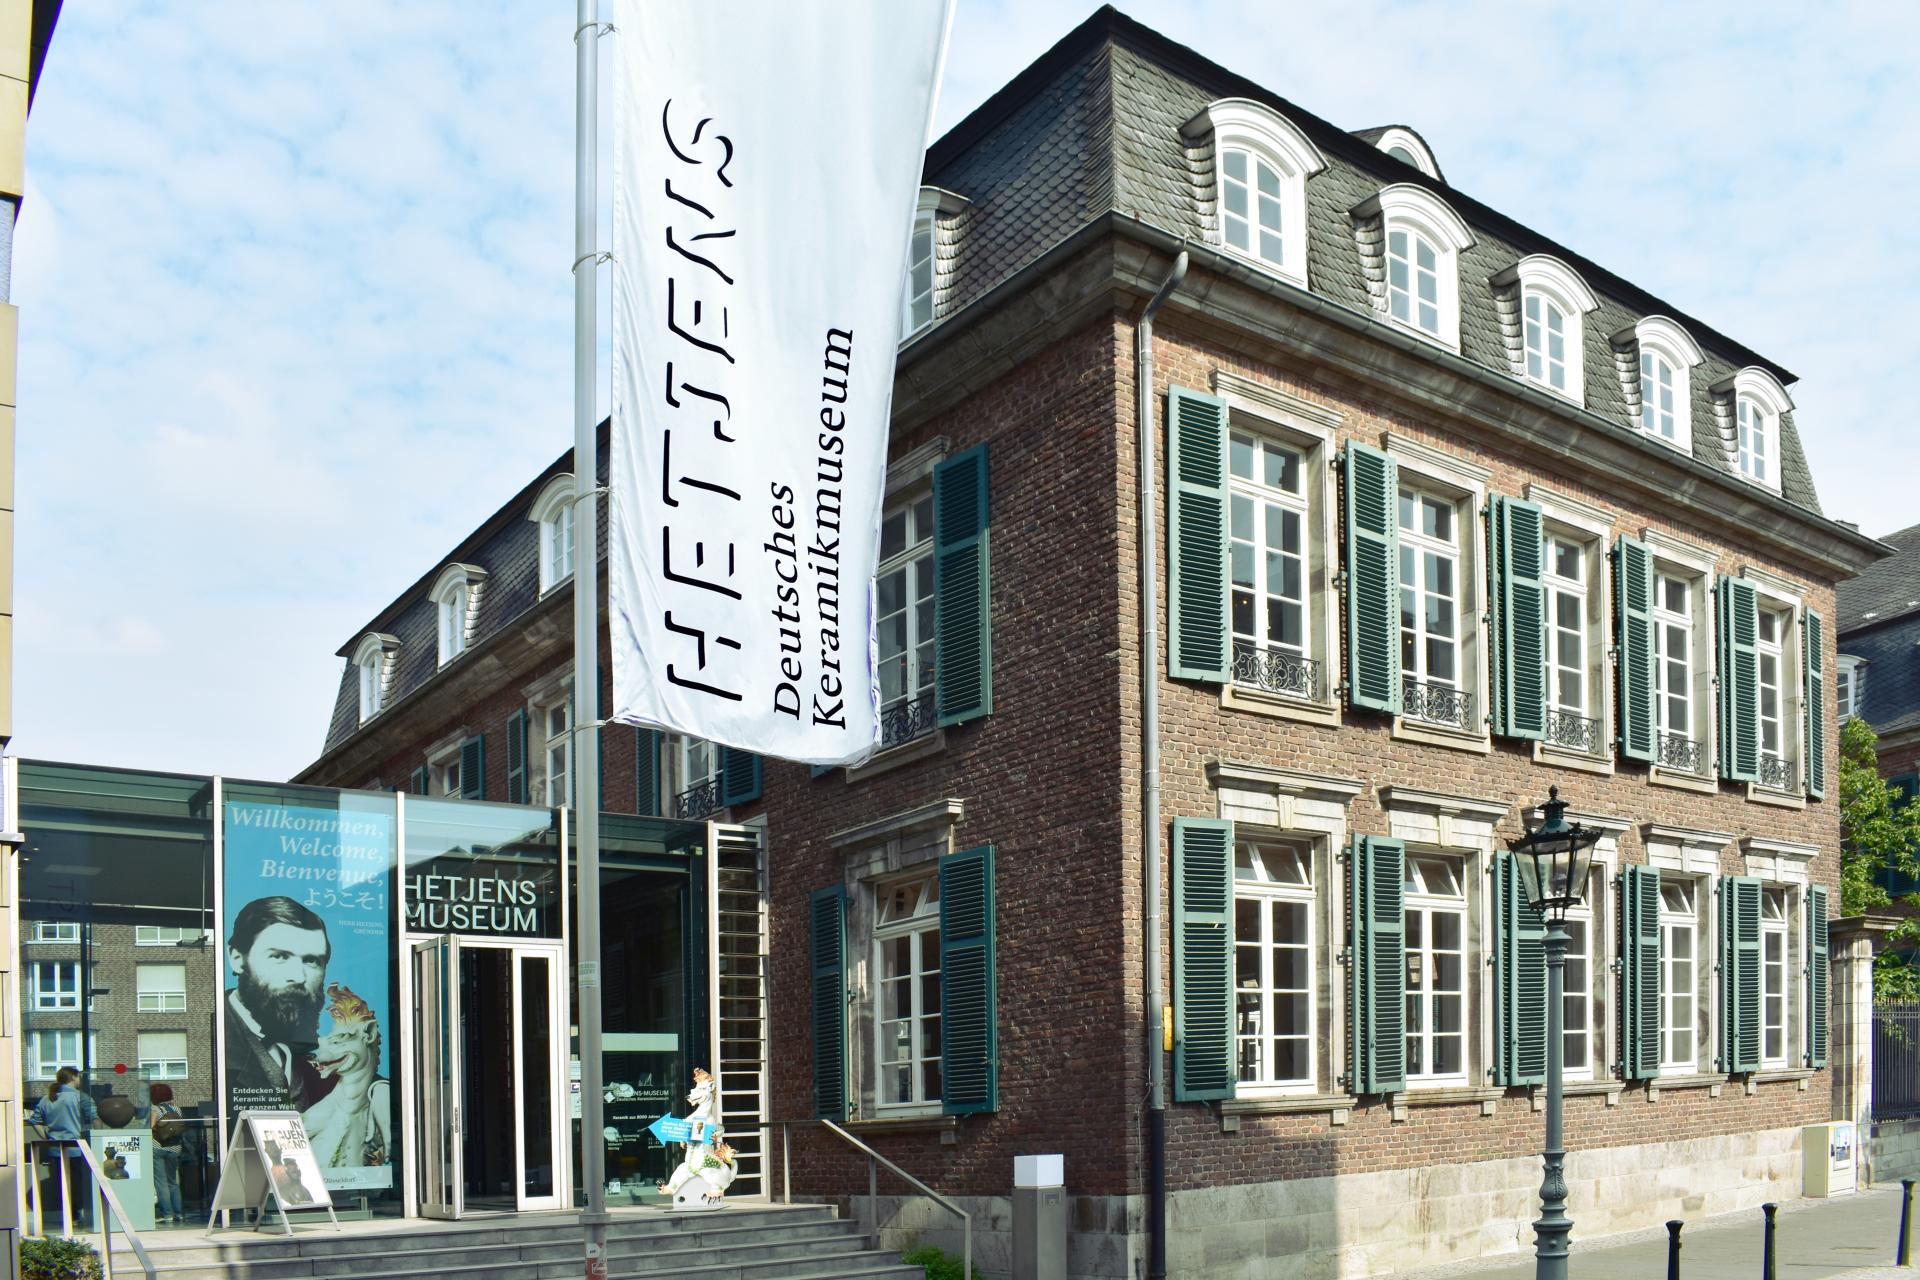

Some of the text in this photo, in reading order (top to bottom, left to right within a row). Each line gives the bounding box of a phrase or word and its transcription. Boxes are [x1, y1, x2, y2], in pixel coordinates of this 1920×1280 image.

[662, 98, 743, 702] HETJENS
[807, 328, 853, 730] Keramikmuseum
[763, 481, 801, 721] Deutsches
[231, 806, 384, 839] Willkommen,
[279, 836, 384, 865] Welcome,
[259, 859, 384, 887] Bienvenue,
[405, 874, 537, 905] HETJENS
[405, 902, 537, 932] MUSEUM
[232, 1095, 266, 1103] Keramik
[289, 1120, 302, 1130] IN
